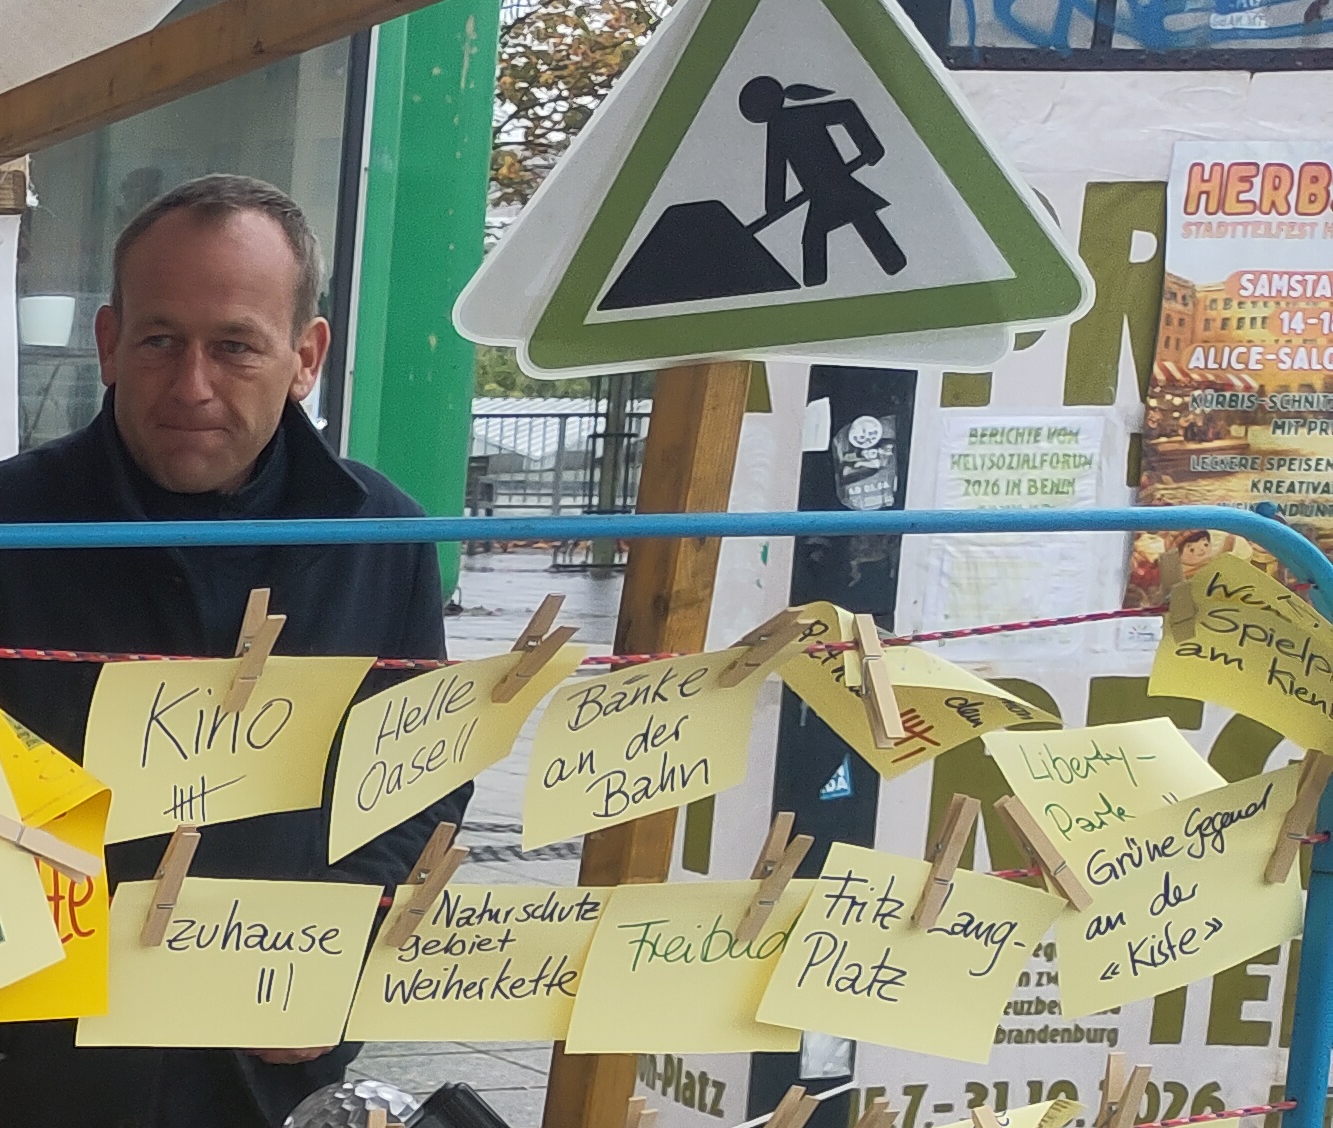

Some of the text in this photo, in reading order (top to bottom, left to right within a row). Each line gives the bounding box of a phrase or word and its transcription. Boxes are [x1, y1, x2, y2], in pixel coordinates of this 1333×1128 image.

[1183, 161, 1333, 216] HERB
[1279, 311, 1333, 335] 14-1
[1271, 419, 1304, 436] MIT
[1175, 642, 1244, 671] am
[141, 681, 293, 768] Kino
[375, 674, 477, 755] Helle
[567, 665, 709, 732] Bänke
[543, 715, 690, 789] an der
[586, 755, 710, 819] Bahn
[1086, 782, 1274, 886] Grüne Gegend
[432, 889, 601, 930] Naturschutz
[820, 870, 905, 931] Fritz
[1085, 871, 1199, 941] an der
[397, 928, 516, 963] gebiet
[796, 930, 907, 1003] Platz
